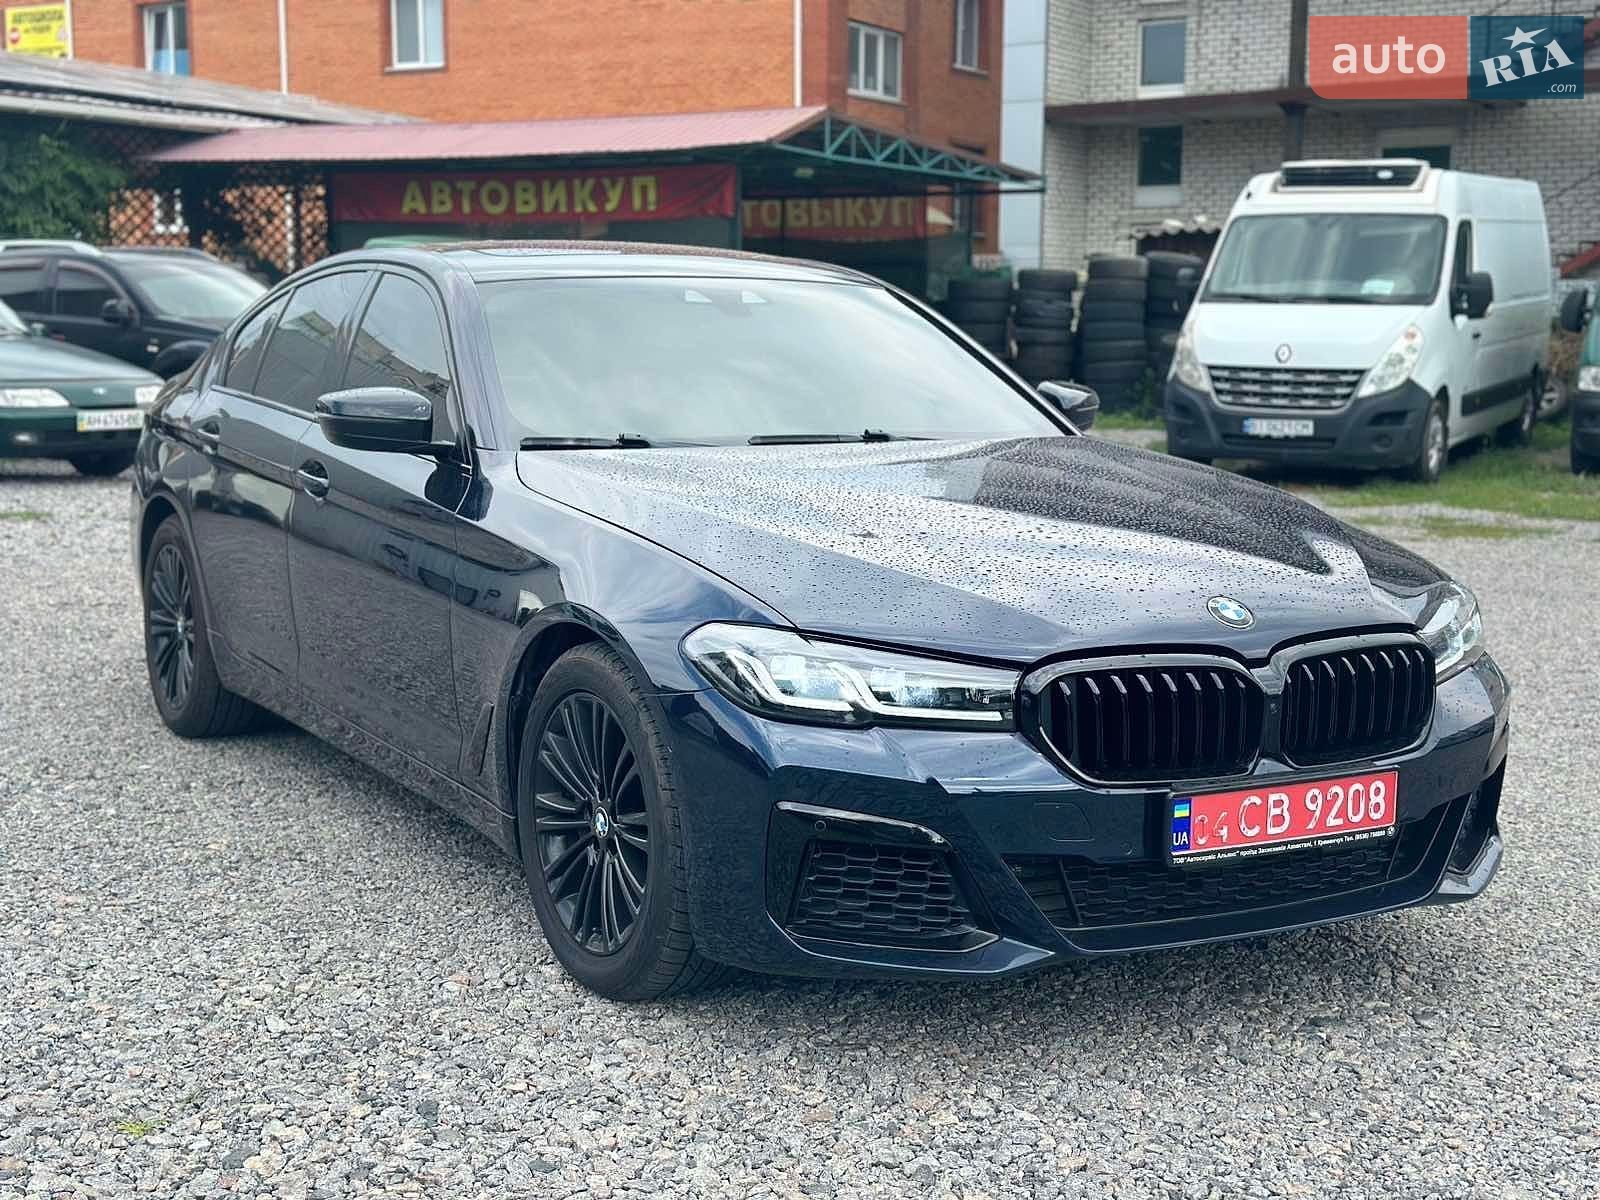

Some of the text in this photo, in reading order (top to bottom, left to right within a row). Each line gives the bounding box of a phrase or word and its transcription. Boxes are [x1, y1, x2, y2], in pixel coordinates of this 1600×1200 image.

[401, 176, 658, 216] АВТОВИКУП
[743, 196, 914, 229] ТОВЫКУП
[1305, 780, 1387, 830] 9208
[1173, 831, 1189, 846] UA
